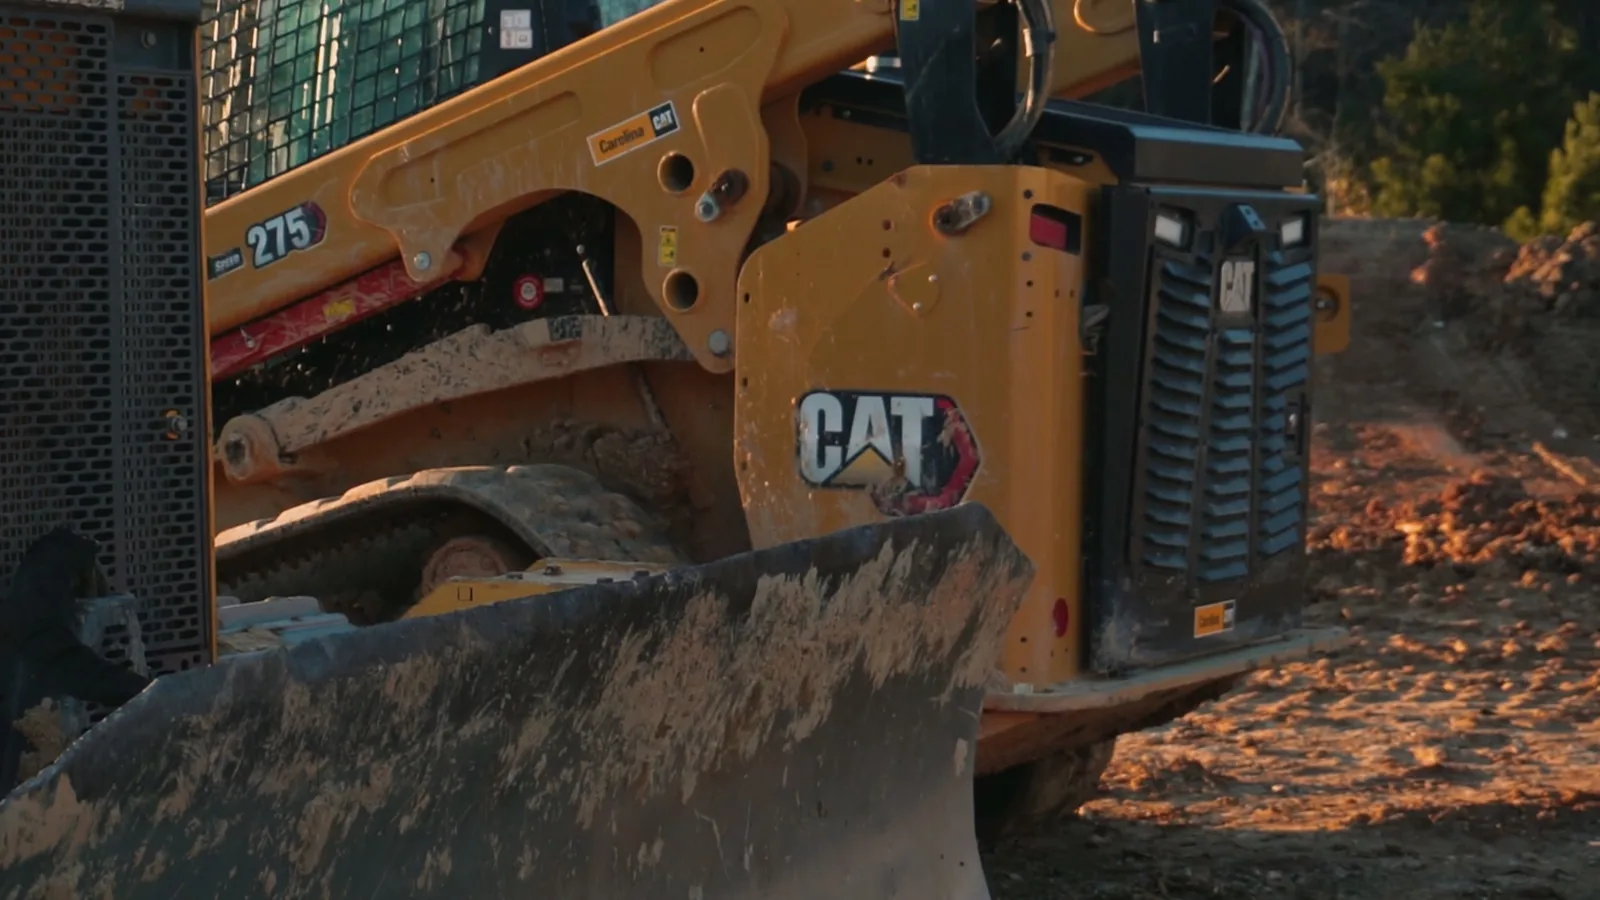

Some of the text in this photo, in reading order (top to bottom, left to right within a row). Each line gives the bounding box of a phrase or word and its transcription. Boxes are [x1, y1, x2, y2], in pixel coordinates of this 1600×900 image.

[598, 109, 673, 154] Carolina CAT
[247, 207, 311, 267] 275
[1220, 261, 1254, 312] CAT
[800, 392, 934, 489] CAT
